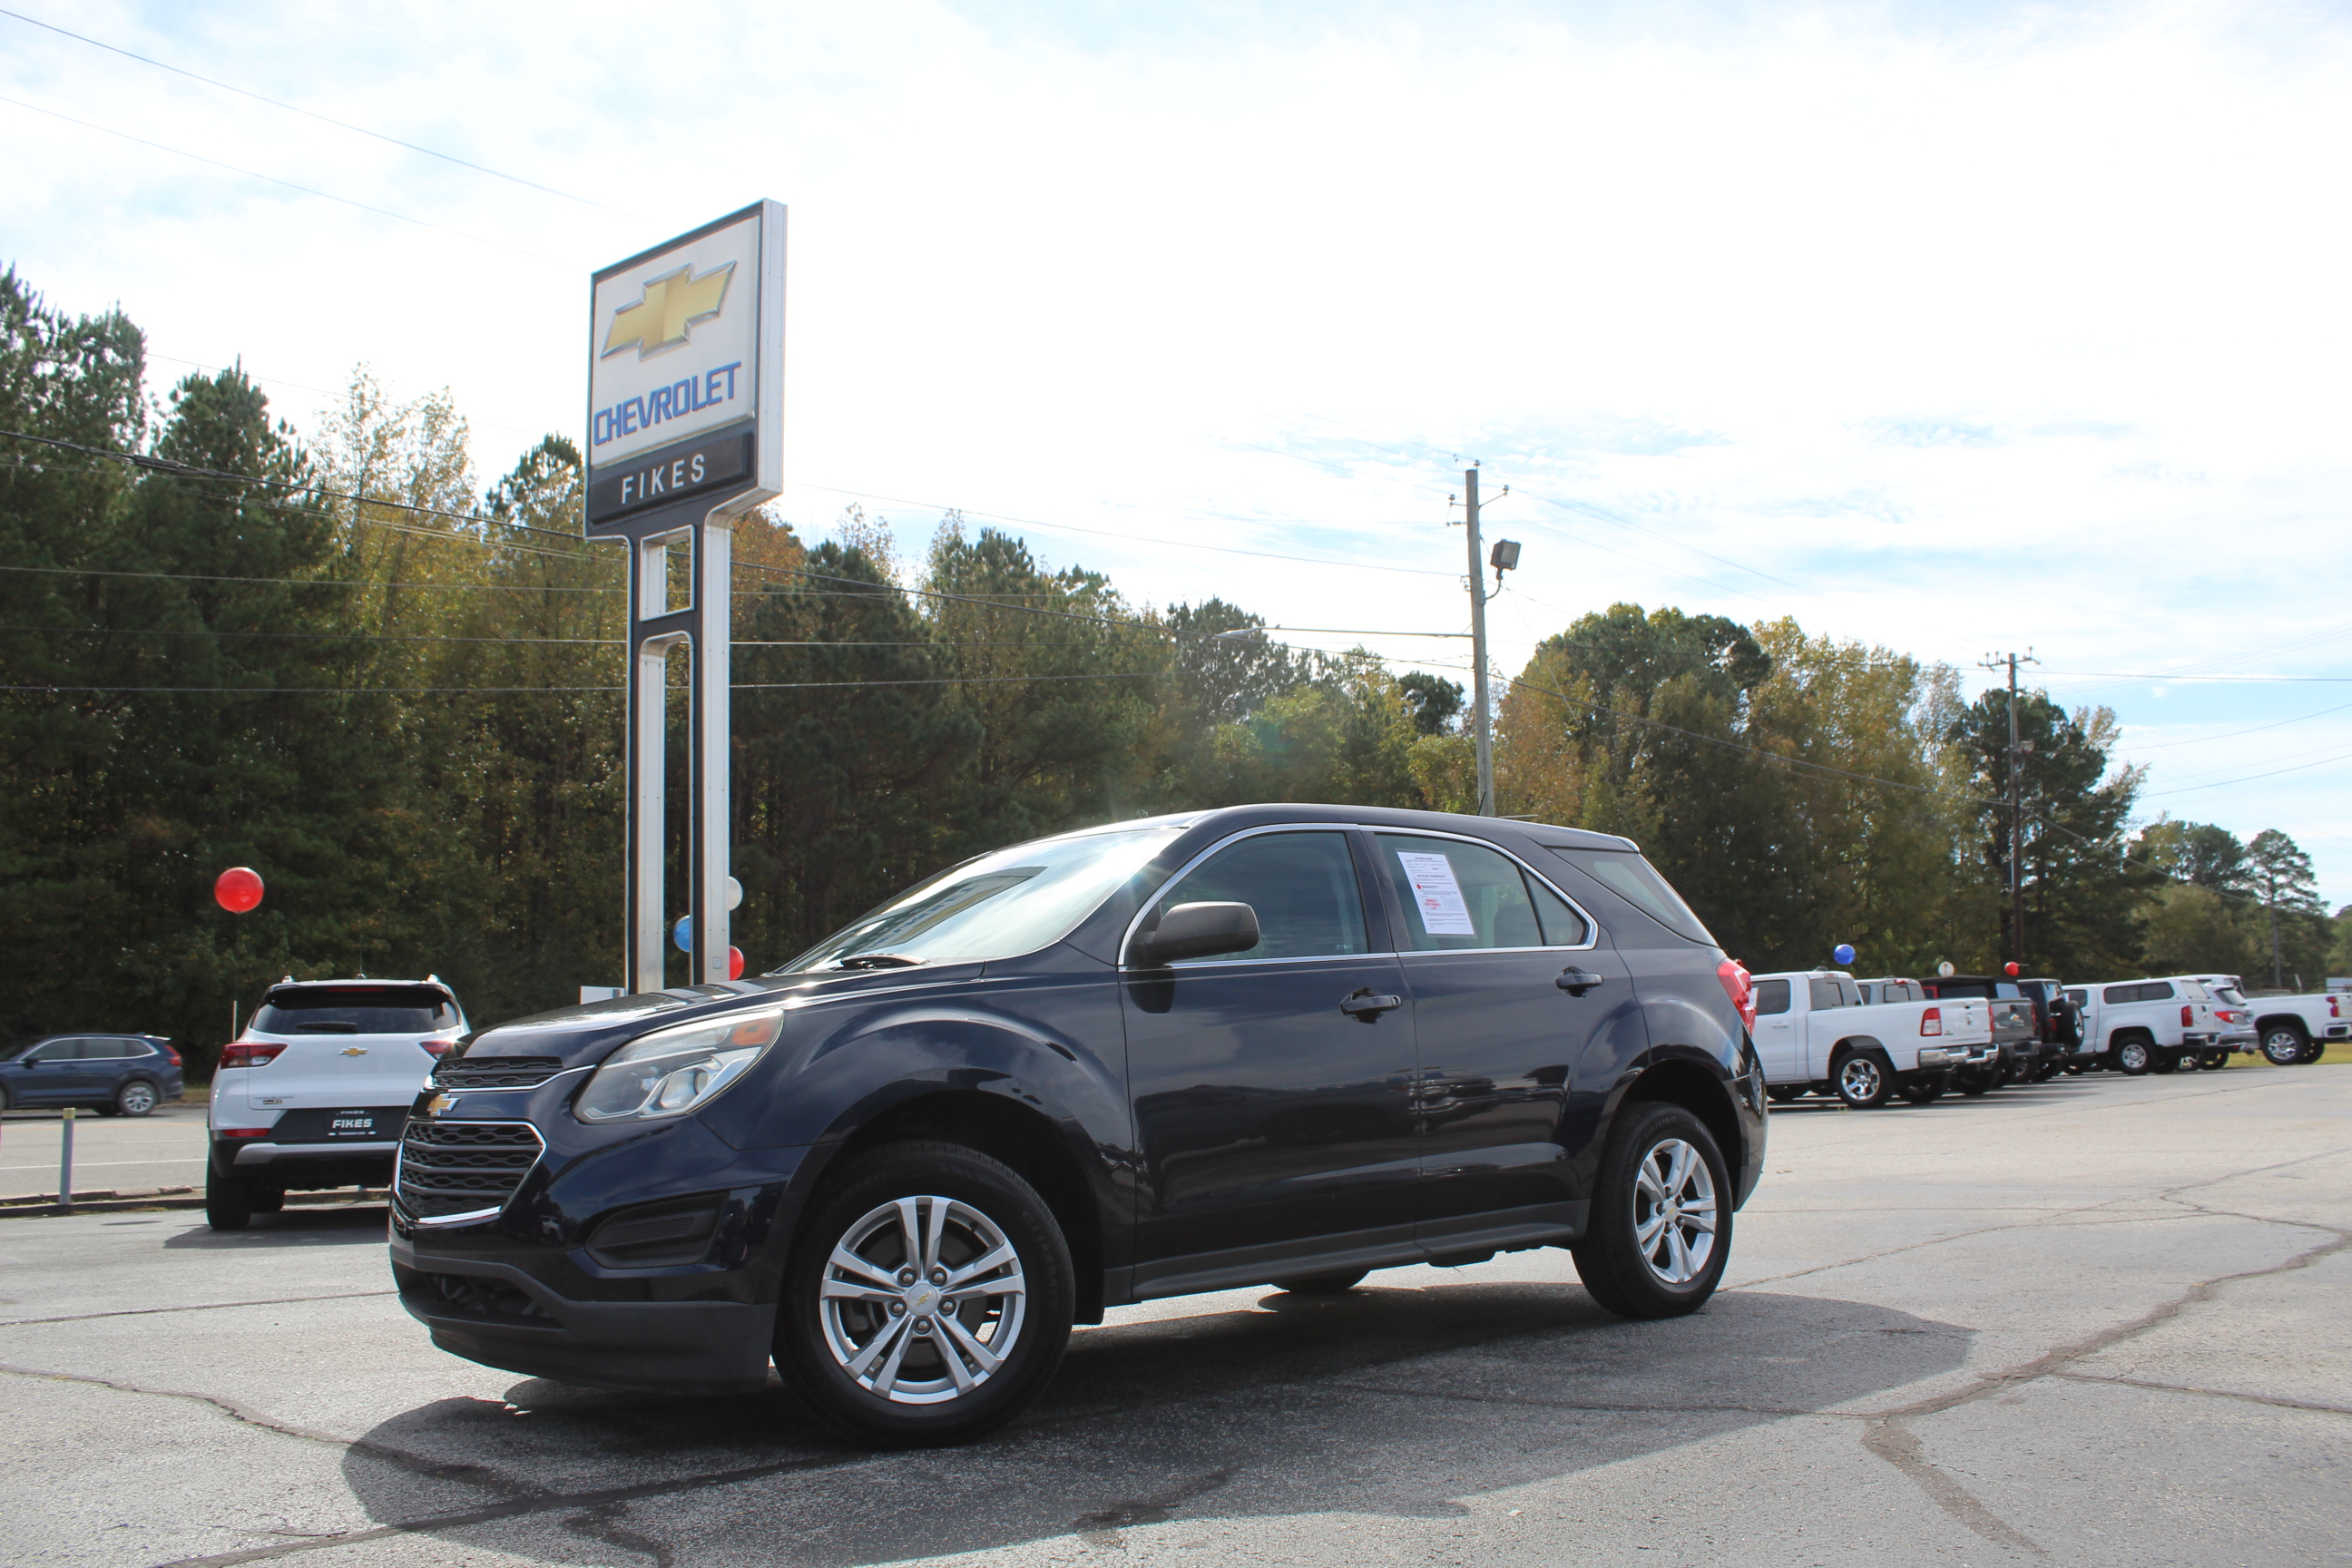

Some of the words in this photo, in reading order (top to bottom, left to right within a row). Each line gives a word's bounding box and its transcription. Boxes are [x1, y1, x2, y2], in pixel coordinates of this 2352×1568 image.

[593, 360, 741, 446] CHEVROLET
[622, 454, 706, 504] FIKES
[331, 1118, 373, 1129] FIKES
